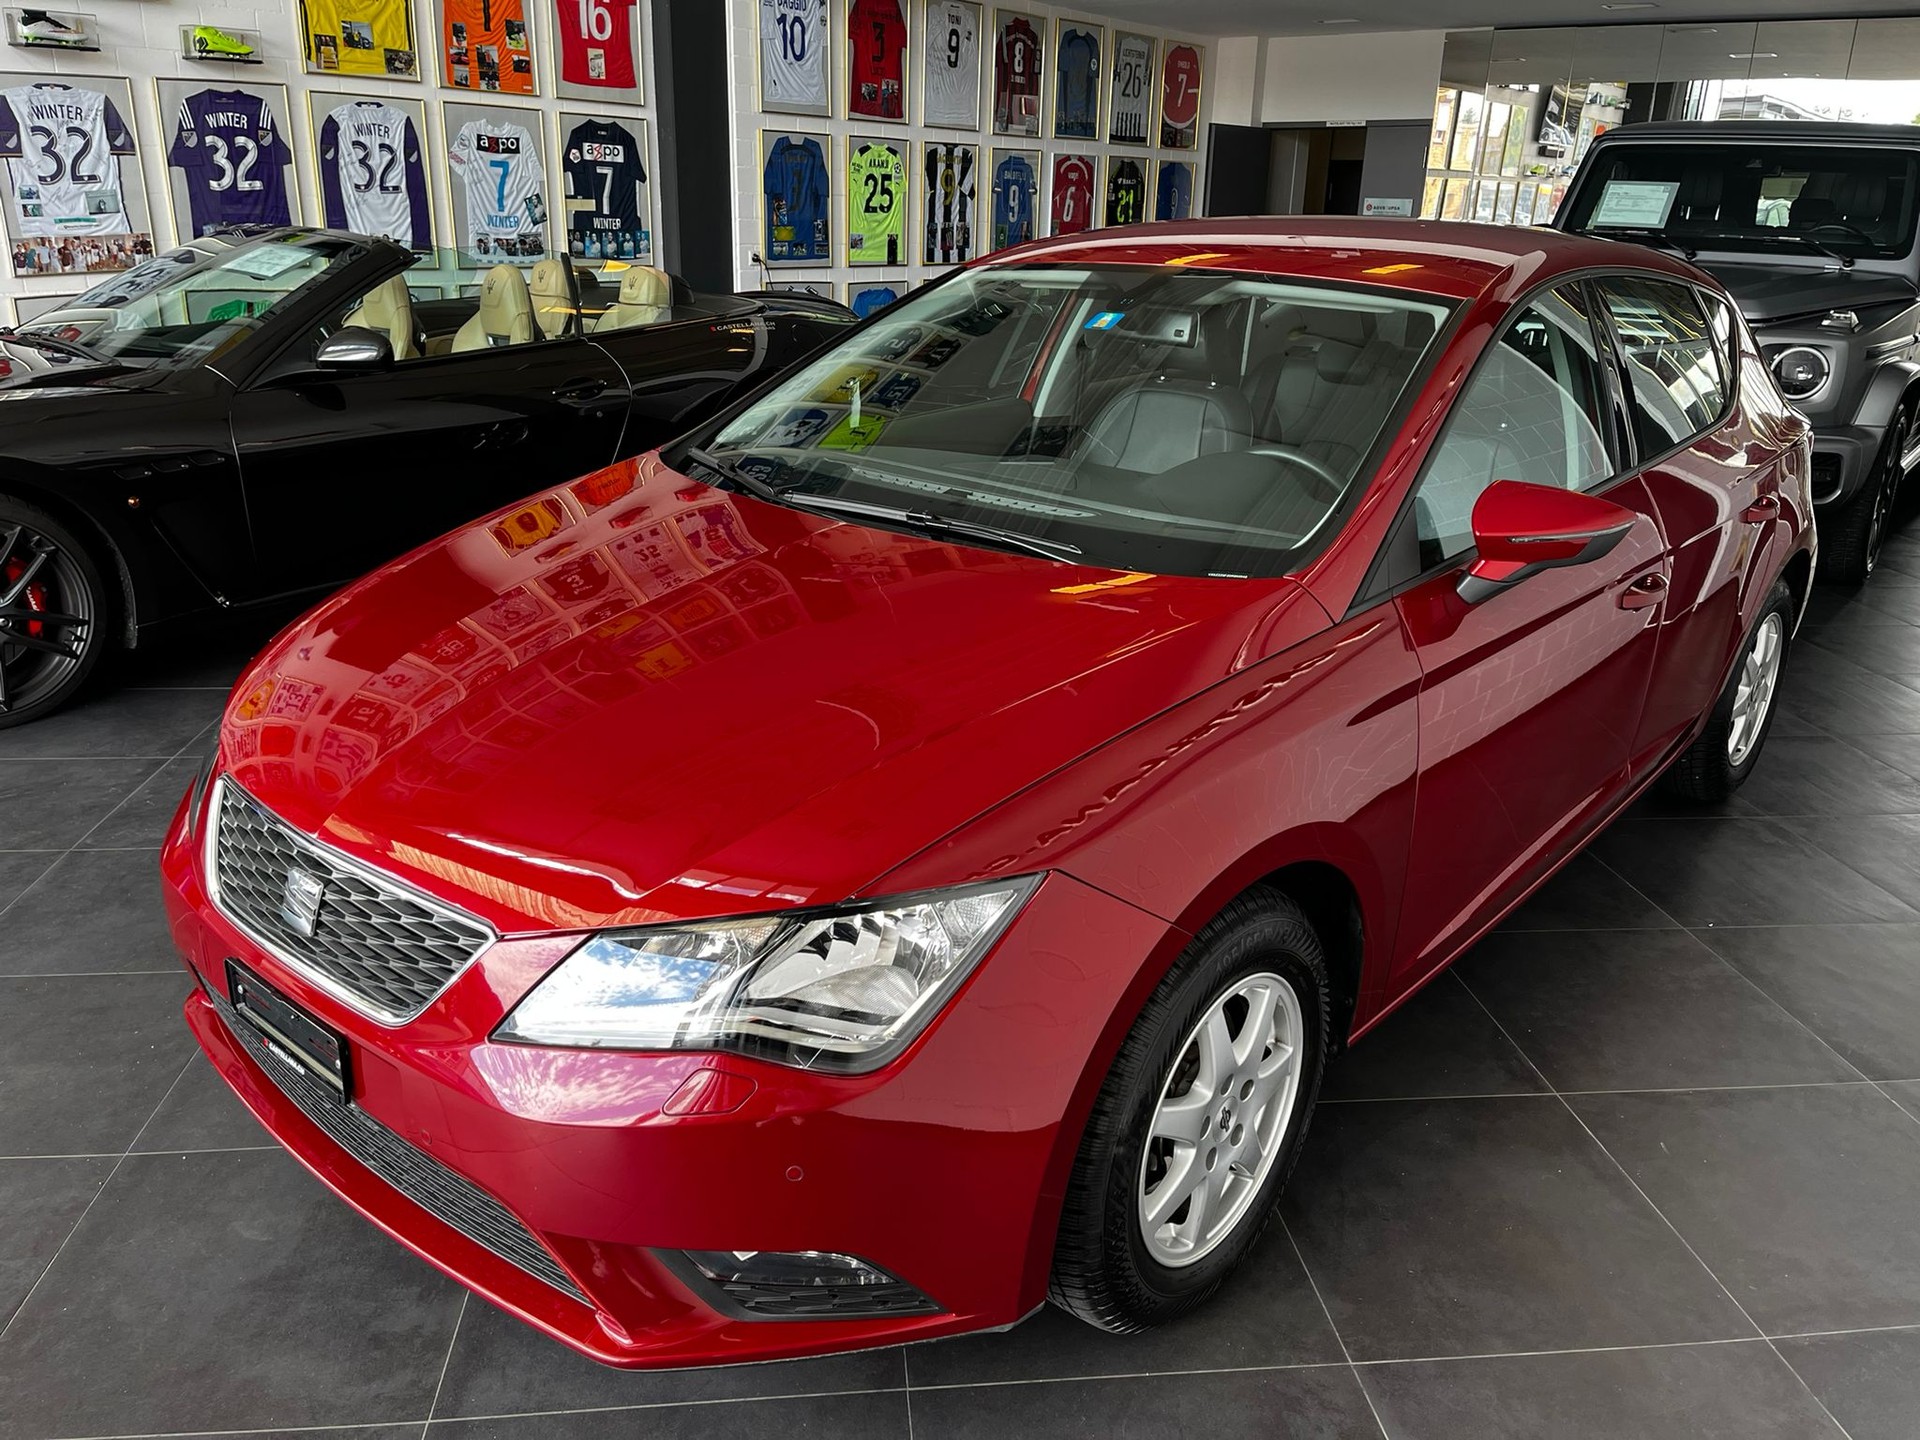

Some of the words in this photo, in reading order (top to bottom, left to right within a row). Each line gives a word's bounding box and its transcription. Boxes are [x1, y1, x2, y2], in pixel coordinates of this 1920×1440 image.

[578, 0, 613, 41] 16
[776, 13, 806, 61] 10
[948, 13, 961, 26] TONI
[872, 21, 885, 62] 3
[947, 28, 960, 68] 9
[1013, 41, 1025, 74] 8
[1121, 62, 1142, 98] 26
[1178, 73, 1188, 107] 7
[32, 104, 83, 122] WINTER
[205, 112, 248, 130] WINTER
[353, 122, 390, 140] WINTER
[30, 125, 101, 184] 32
[204, 135, 263, 191] 32
[352, 140, 402, 194] 32
[489, 160, 509, 212] 7
[596, 166, 613, 215] 7
[864, 173, 893, 213] 25
[940, 168, 956, 206] 9
[1009, 185, 1019, 222] 9
[1063, 186, 1076, 222] 6
[487, 214, 519, 228] WINTER
[593, 217, 622, 230] WINTER
[1117, 189, 1134, 223] 21
